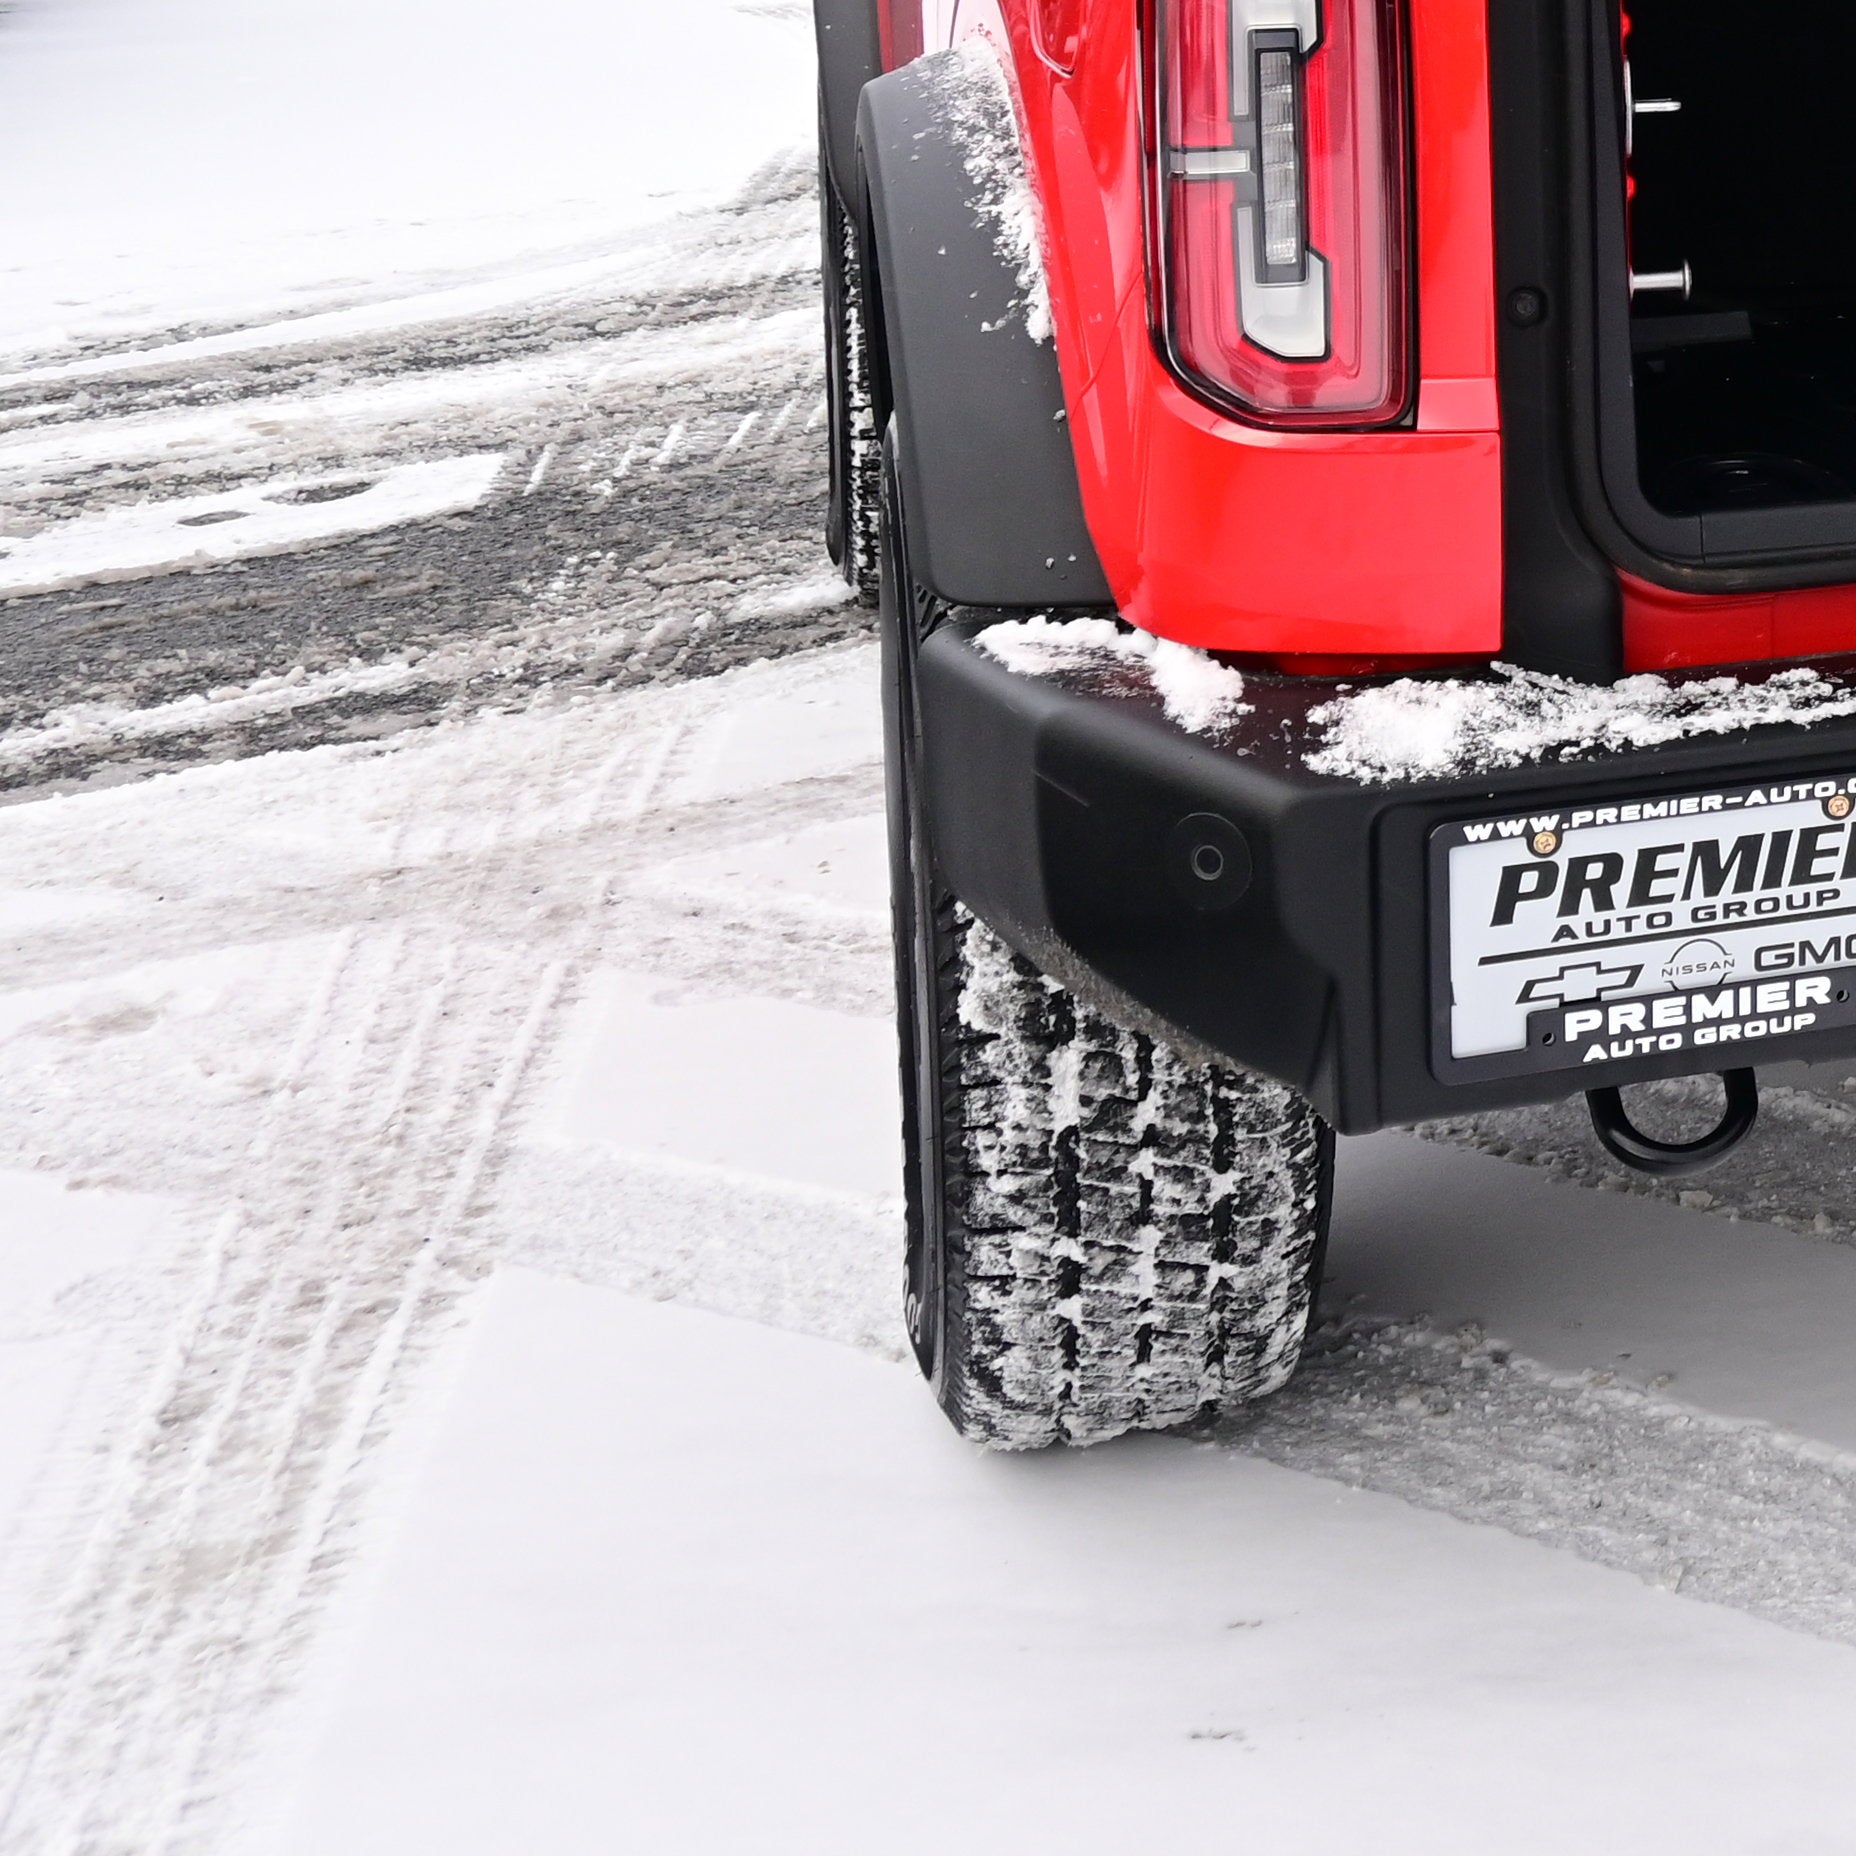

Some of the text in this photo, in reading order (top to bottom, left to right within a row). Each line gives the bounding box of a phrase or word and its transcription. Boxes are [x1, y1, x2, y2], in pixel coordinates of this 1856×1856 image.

[1551, 888, 1841, 943] AUTO GROUP
[1661, 957, 1736, 977] NISSAN
[1564, 976, 1832, 1042] PREMIER
[1582, 1012, 1816, 1063] AUTO GROUP
